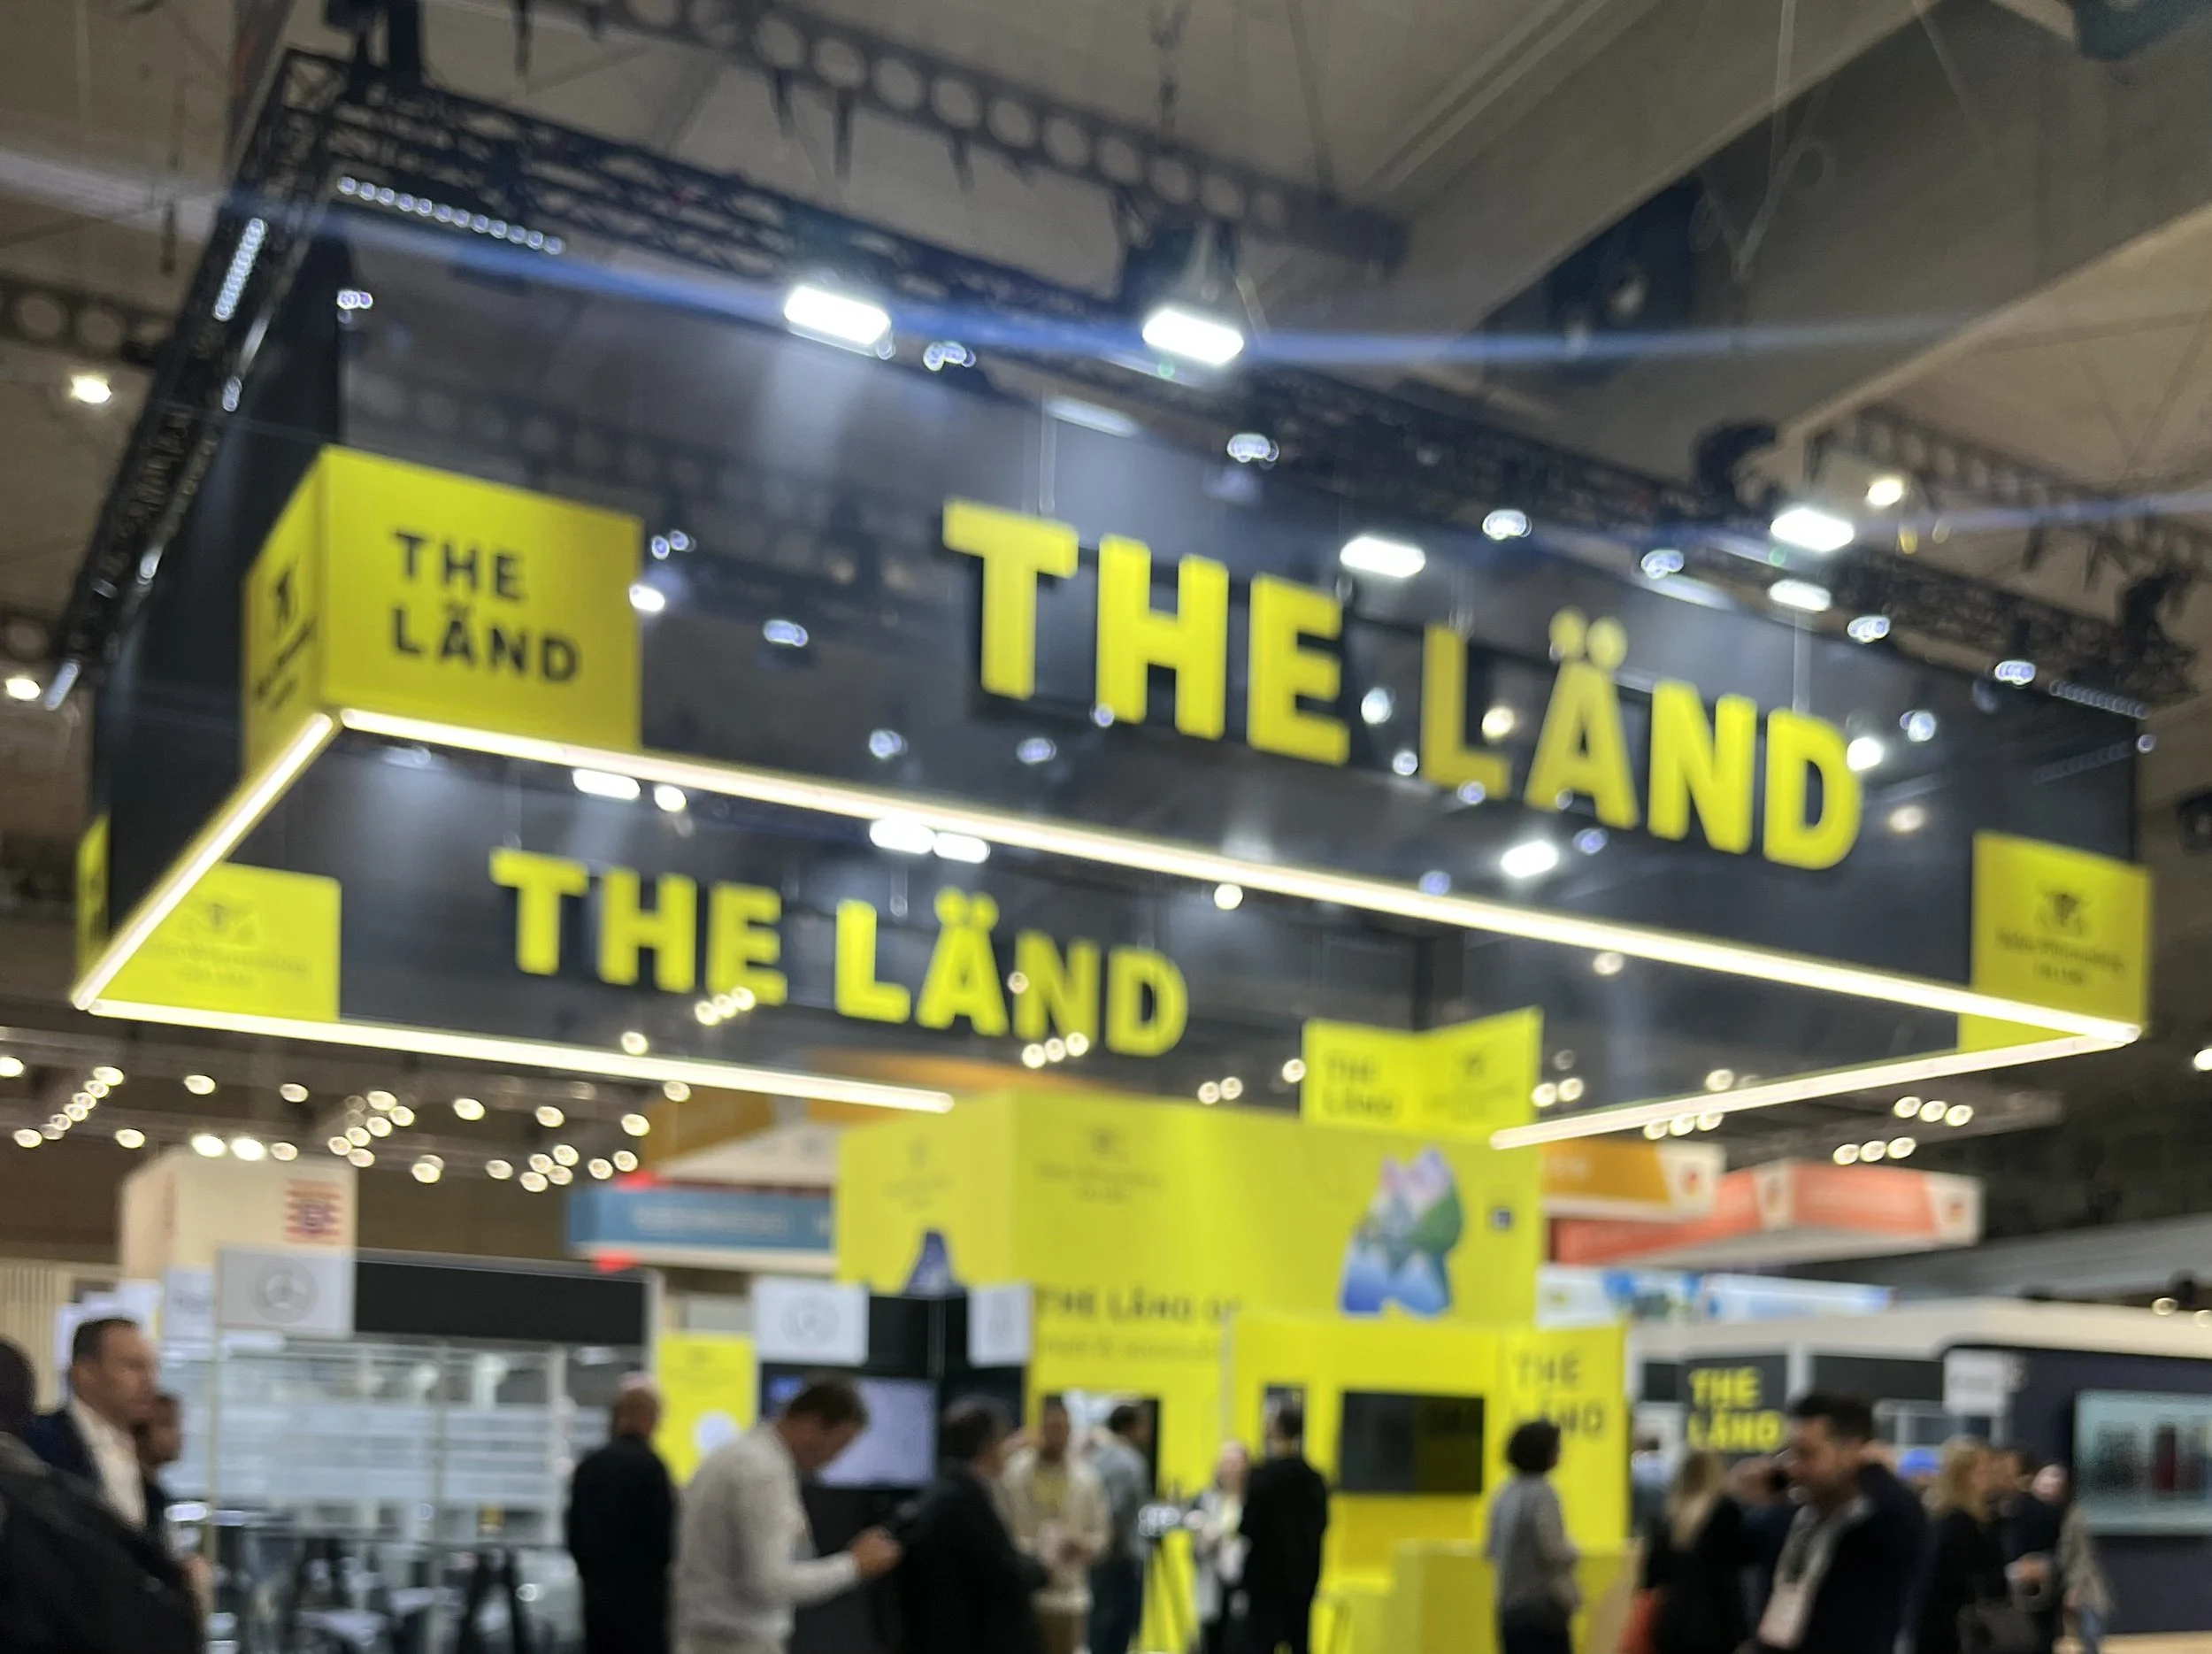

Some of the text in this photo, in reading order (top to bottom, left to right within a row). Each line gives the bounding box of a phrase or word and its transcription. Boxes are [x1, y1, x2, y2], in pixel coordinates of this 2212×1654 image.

[394, 530, 524, 603] THE
[393, 604, 580, 683] LÄND
[943, 496, 1863, 870] THE LÄND
[489, 846, 1189, 1058] THE LÄND
[1688, 1367, 1760, 1409] THE
